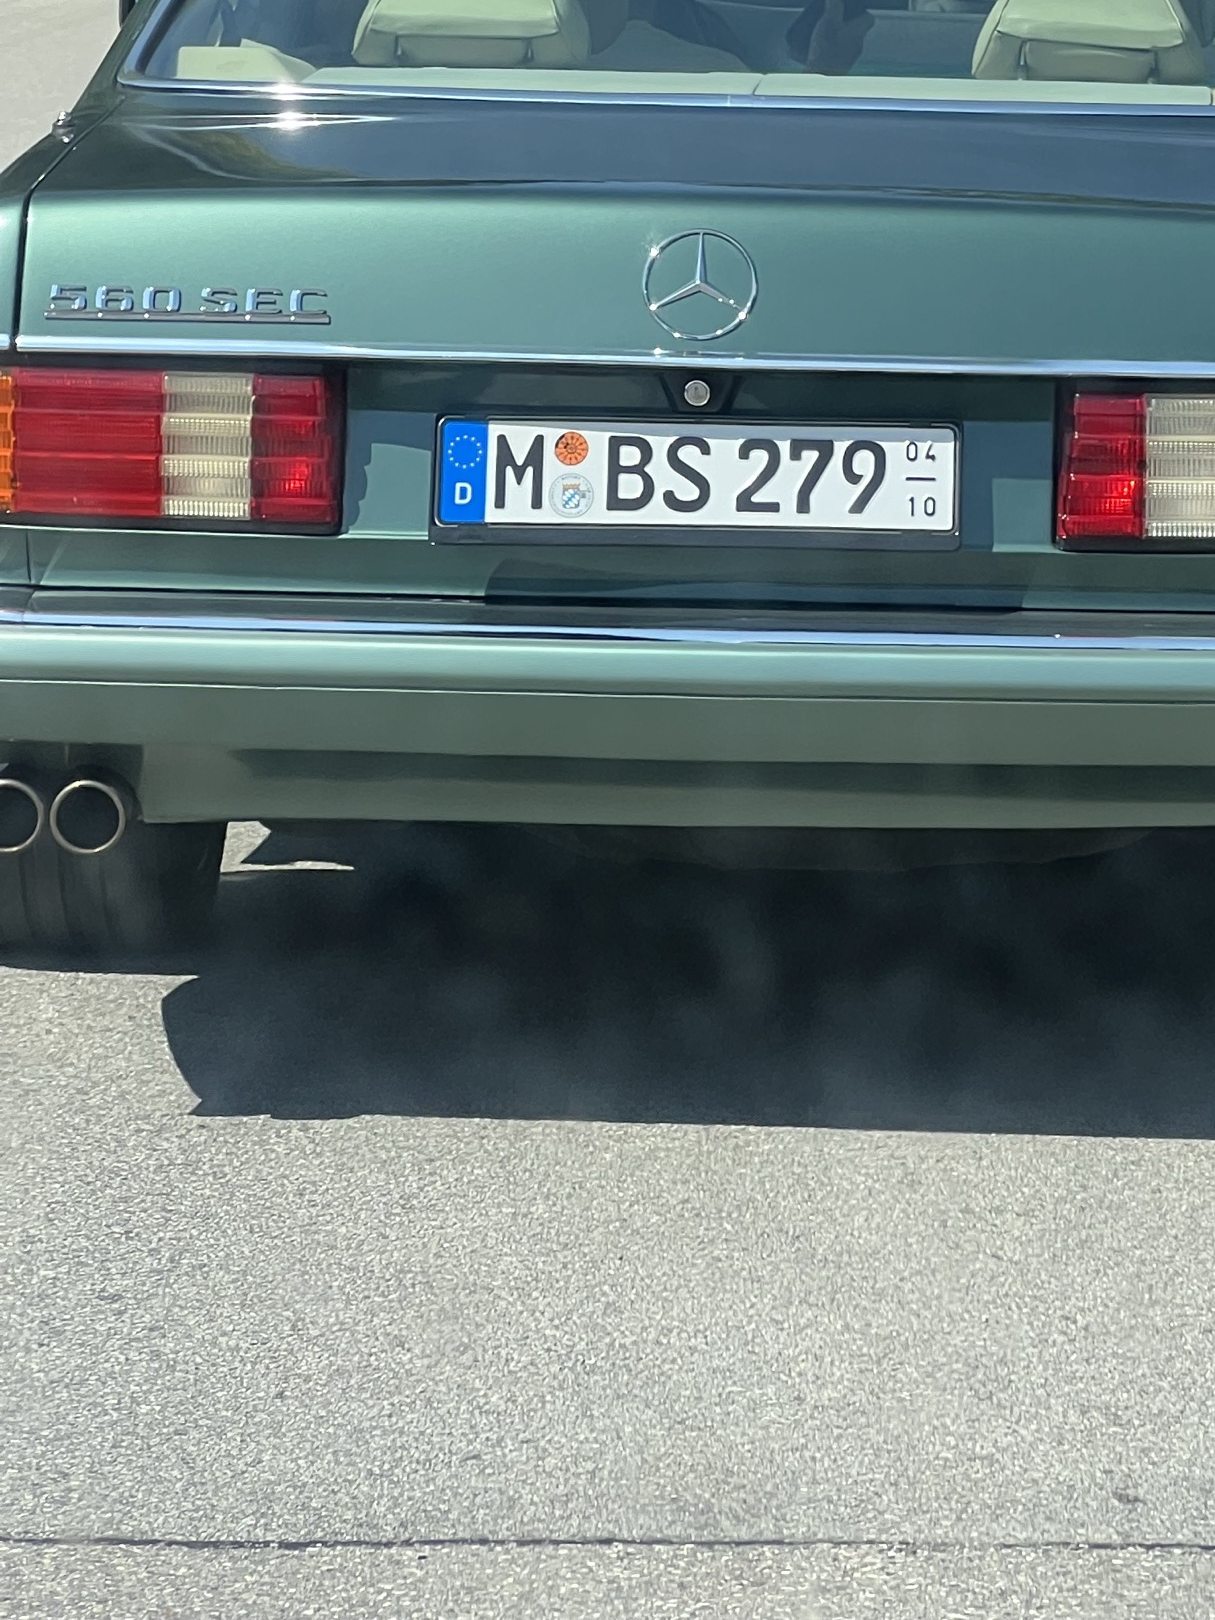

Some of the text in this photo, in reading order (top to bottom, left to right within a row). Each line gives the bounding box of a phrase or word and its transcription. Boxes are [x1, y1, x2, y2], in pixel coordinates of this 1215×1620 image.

[50, 284, 329, 315] 560 SEC
[494, 434, 544, 510] M
[606, 435, 711, 513] BS
[735, 438, 888, 515] 279
[906, 441, 937, 463] 04
[453, 482, 473, 505] D
[907, 496, 937, 517] 10
